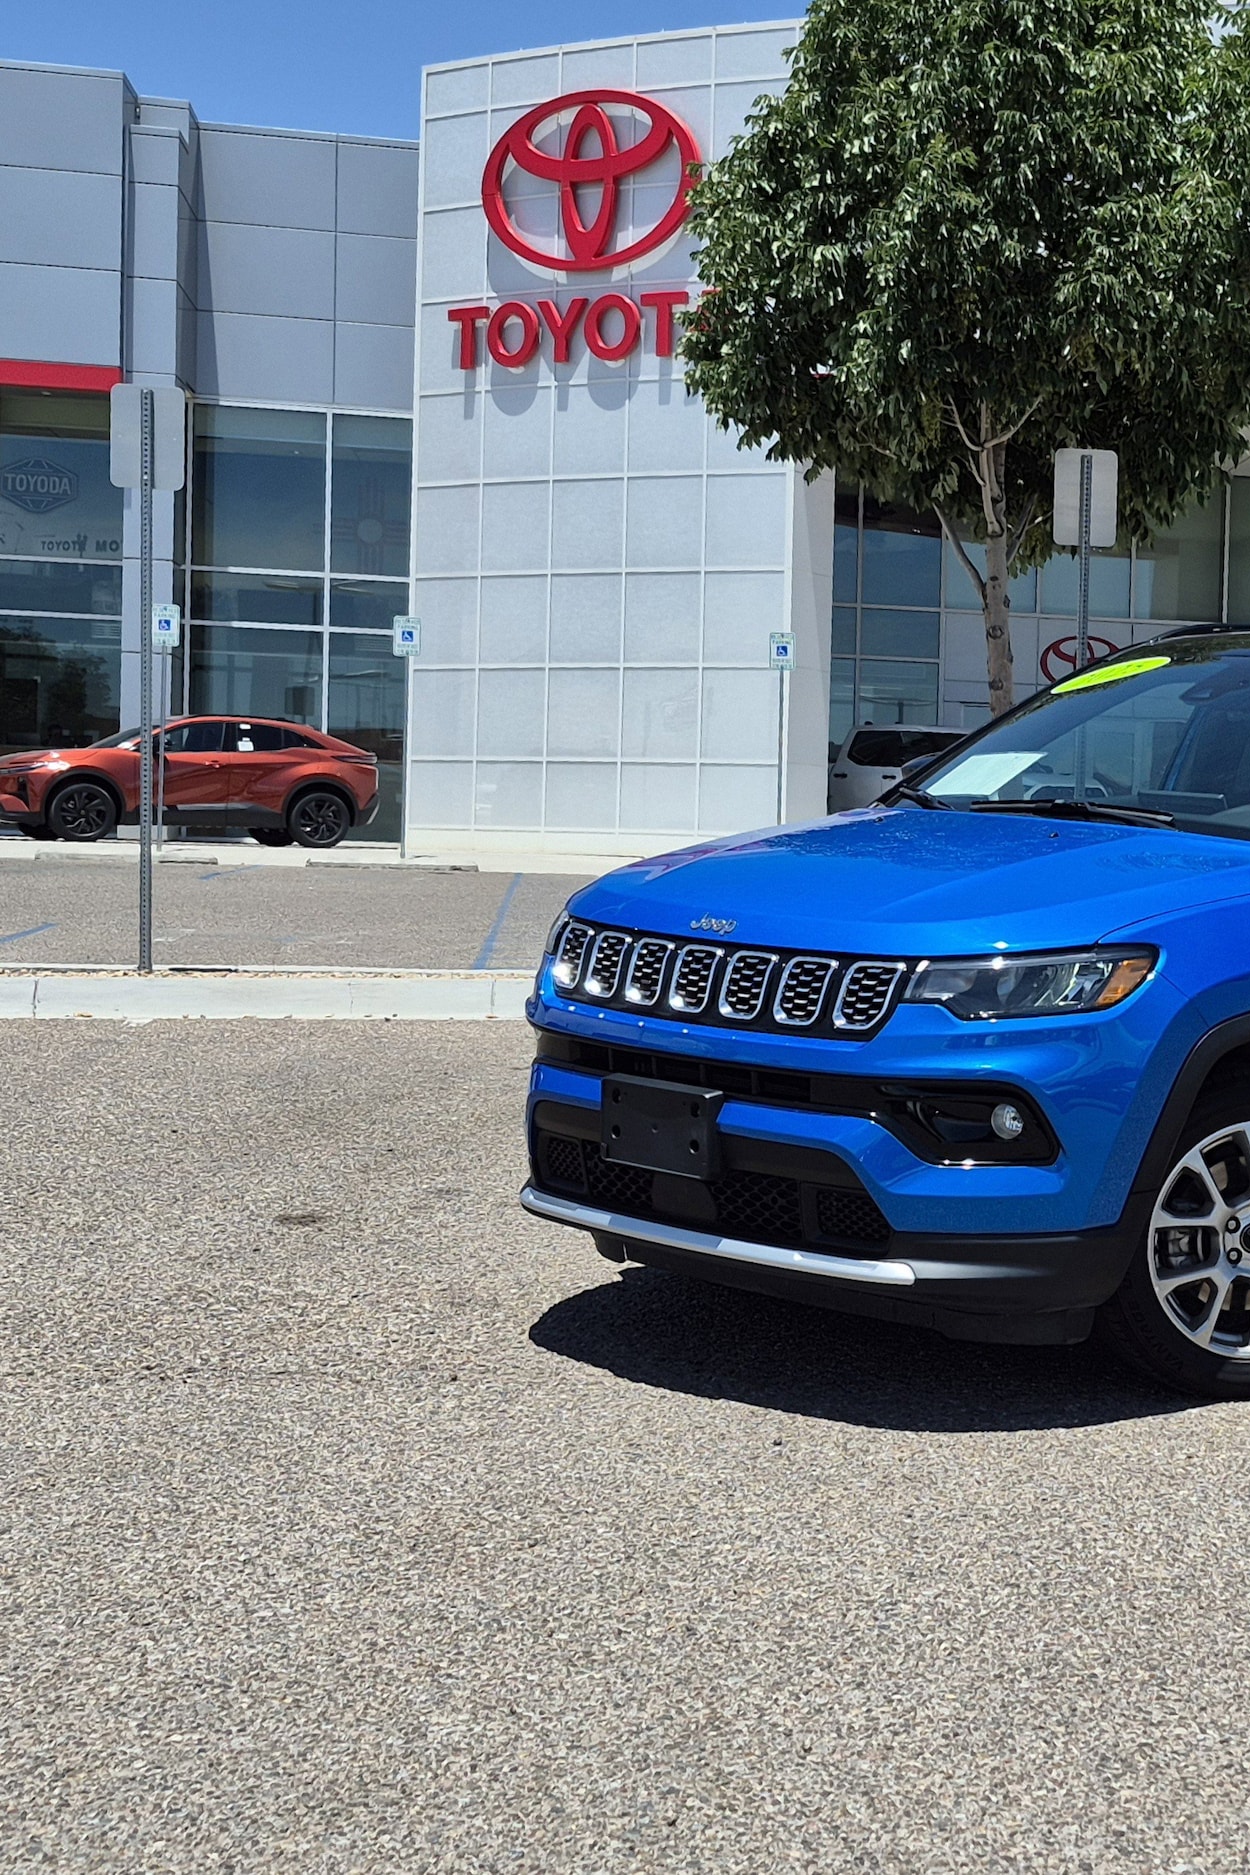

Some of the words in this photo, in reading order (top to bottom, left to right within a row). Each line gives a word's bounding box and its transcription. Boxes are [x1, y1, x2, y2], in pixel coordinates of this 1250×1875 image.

[448, 290, 722, 370] TOYOT
[4, 473, 71, 495] TOYODA
[95, 540, 122, 553] MO
[689, 912, 737, 935] Jeep
